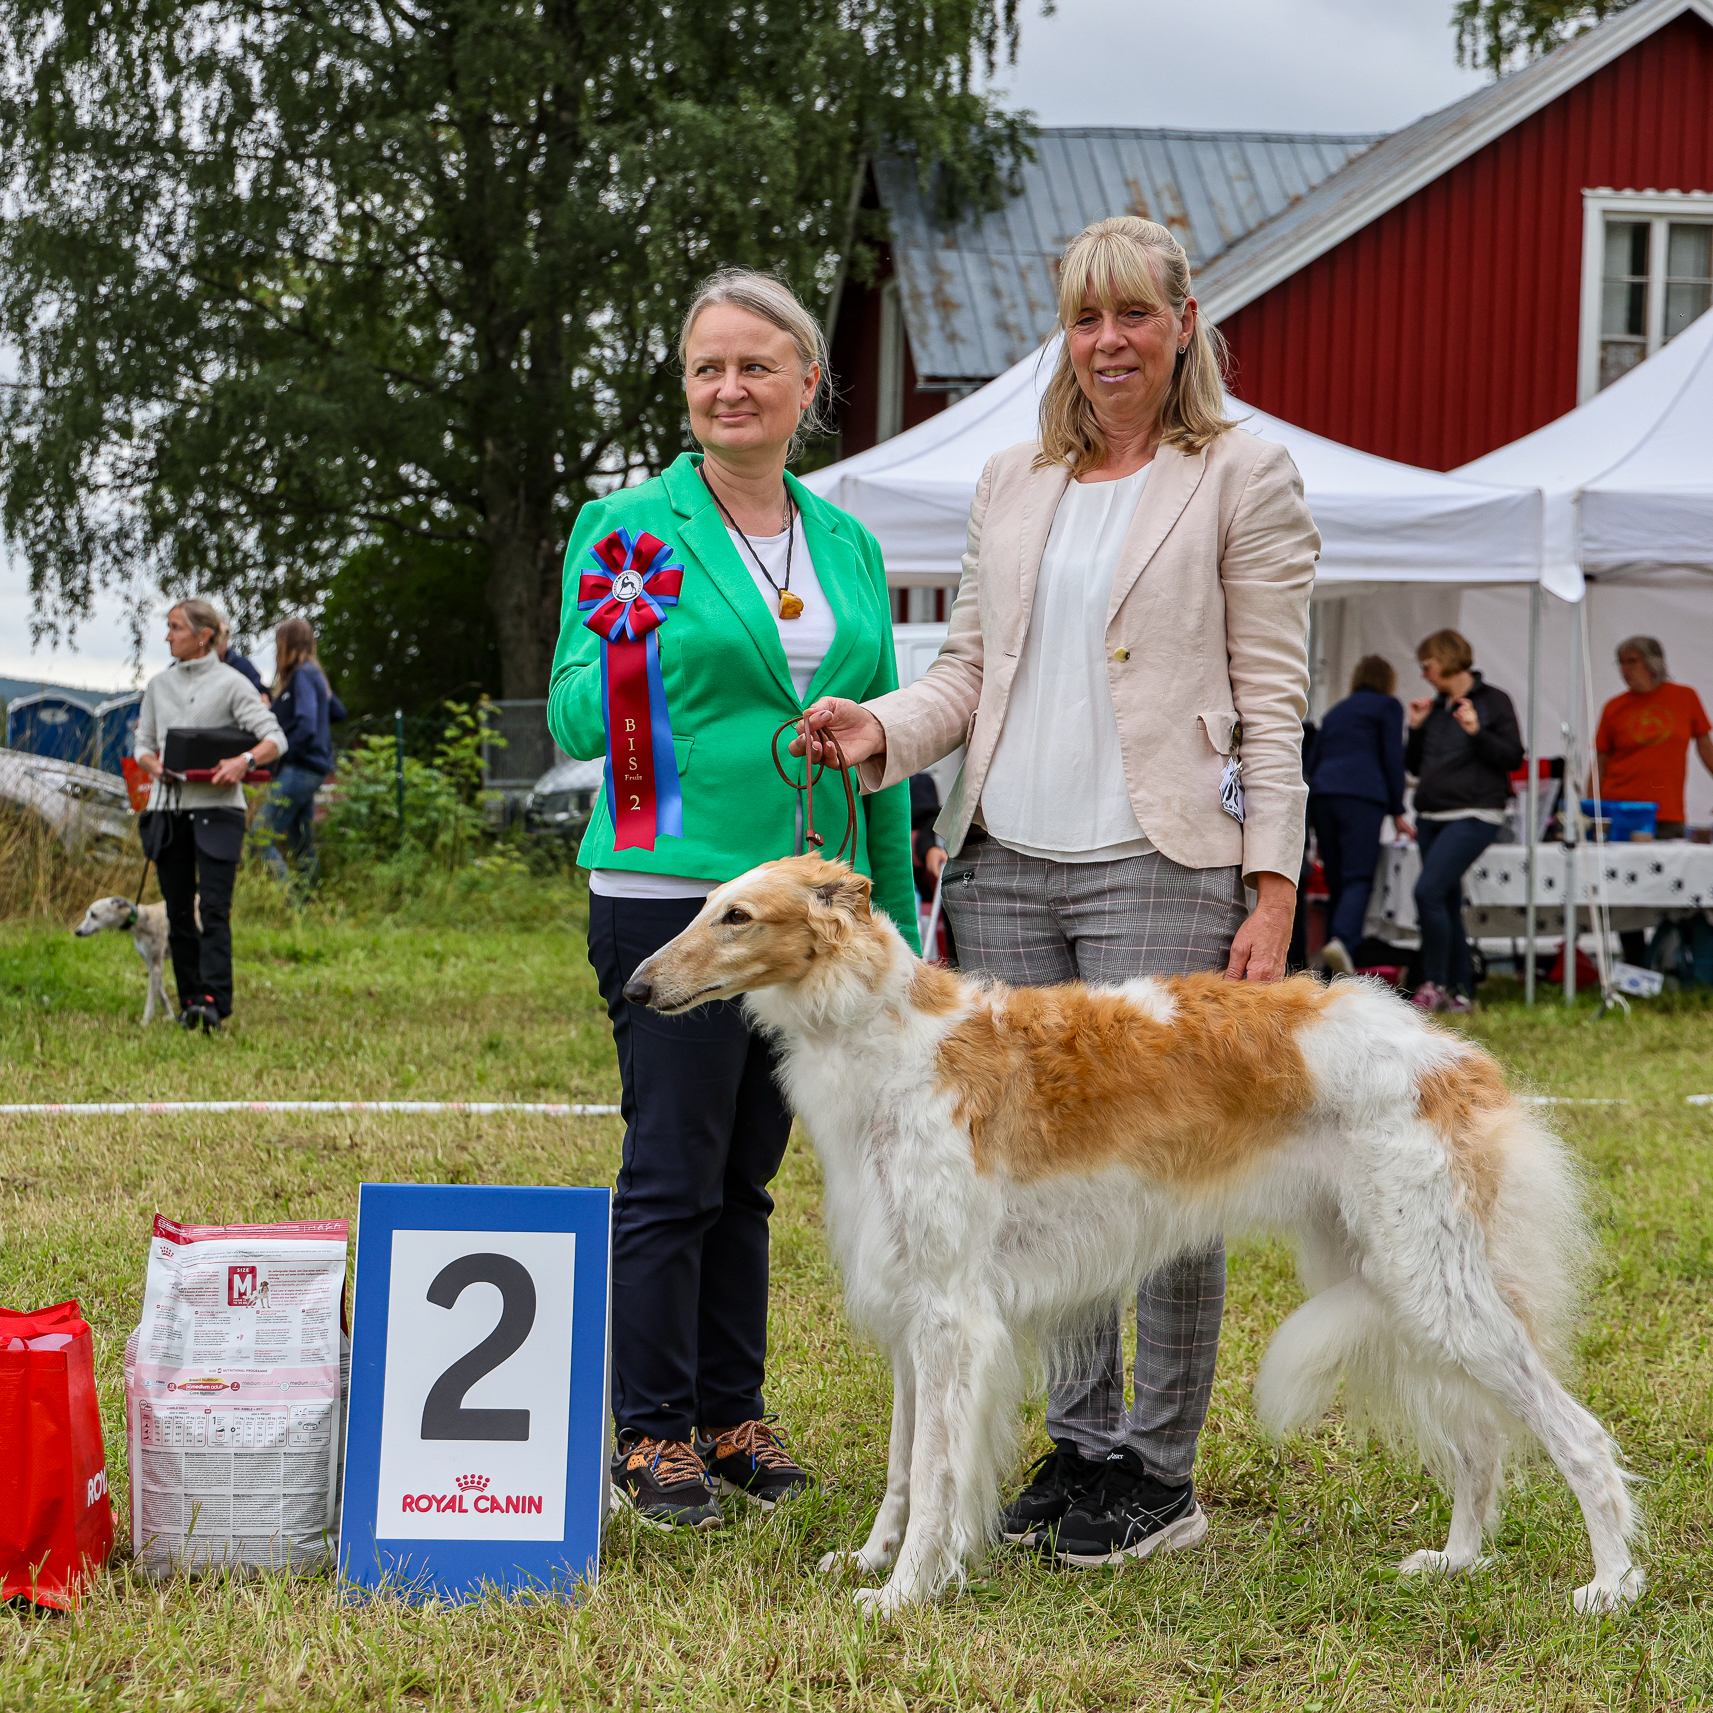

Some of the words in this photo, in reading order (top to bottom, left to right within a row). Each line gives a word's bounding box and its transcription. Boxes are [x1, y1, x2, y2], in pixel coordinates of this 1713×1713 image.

[629, 794, 641, 811] 2
[233, 1273, 253, 1299] M
[421, 1252, 537, 1441] 2
[87, 1465, 108, 1508] ROY
[402, 1493, 469, 1514] ROYAL
[473, 1494, 543, 1515] CANIN
